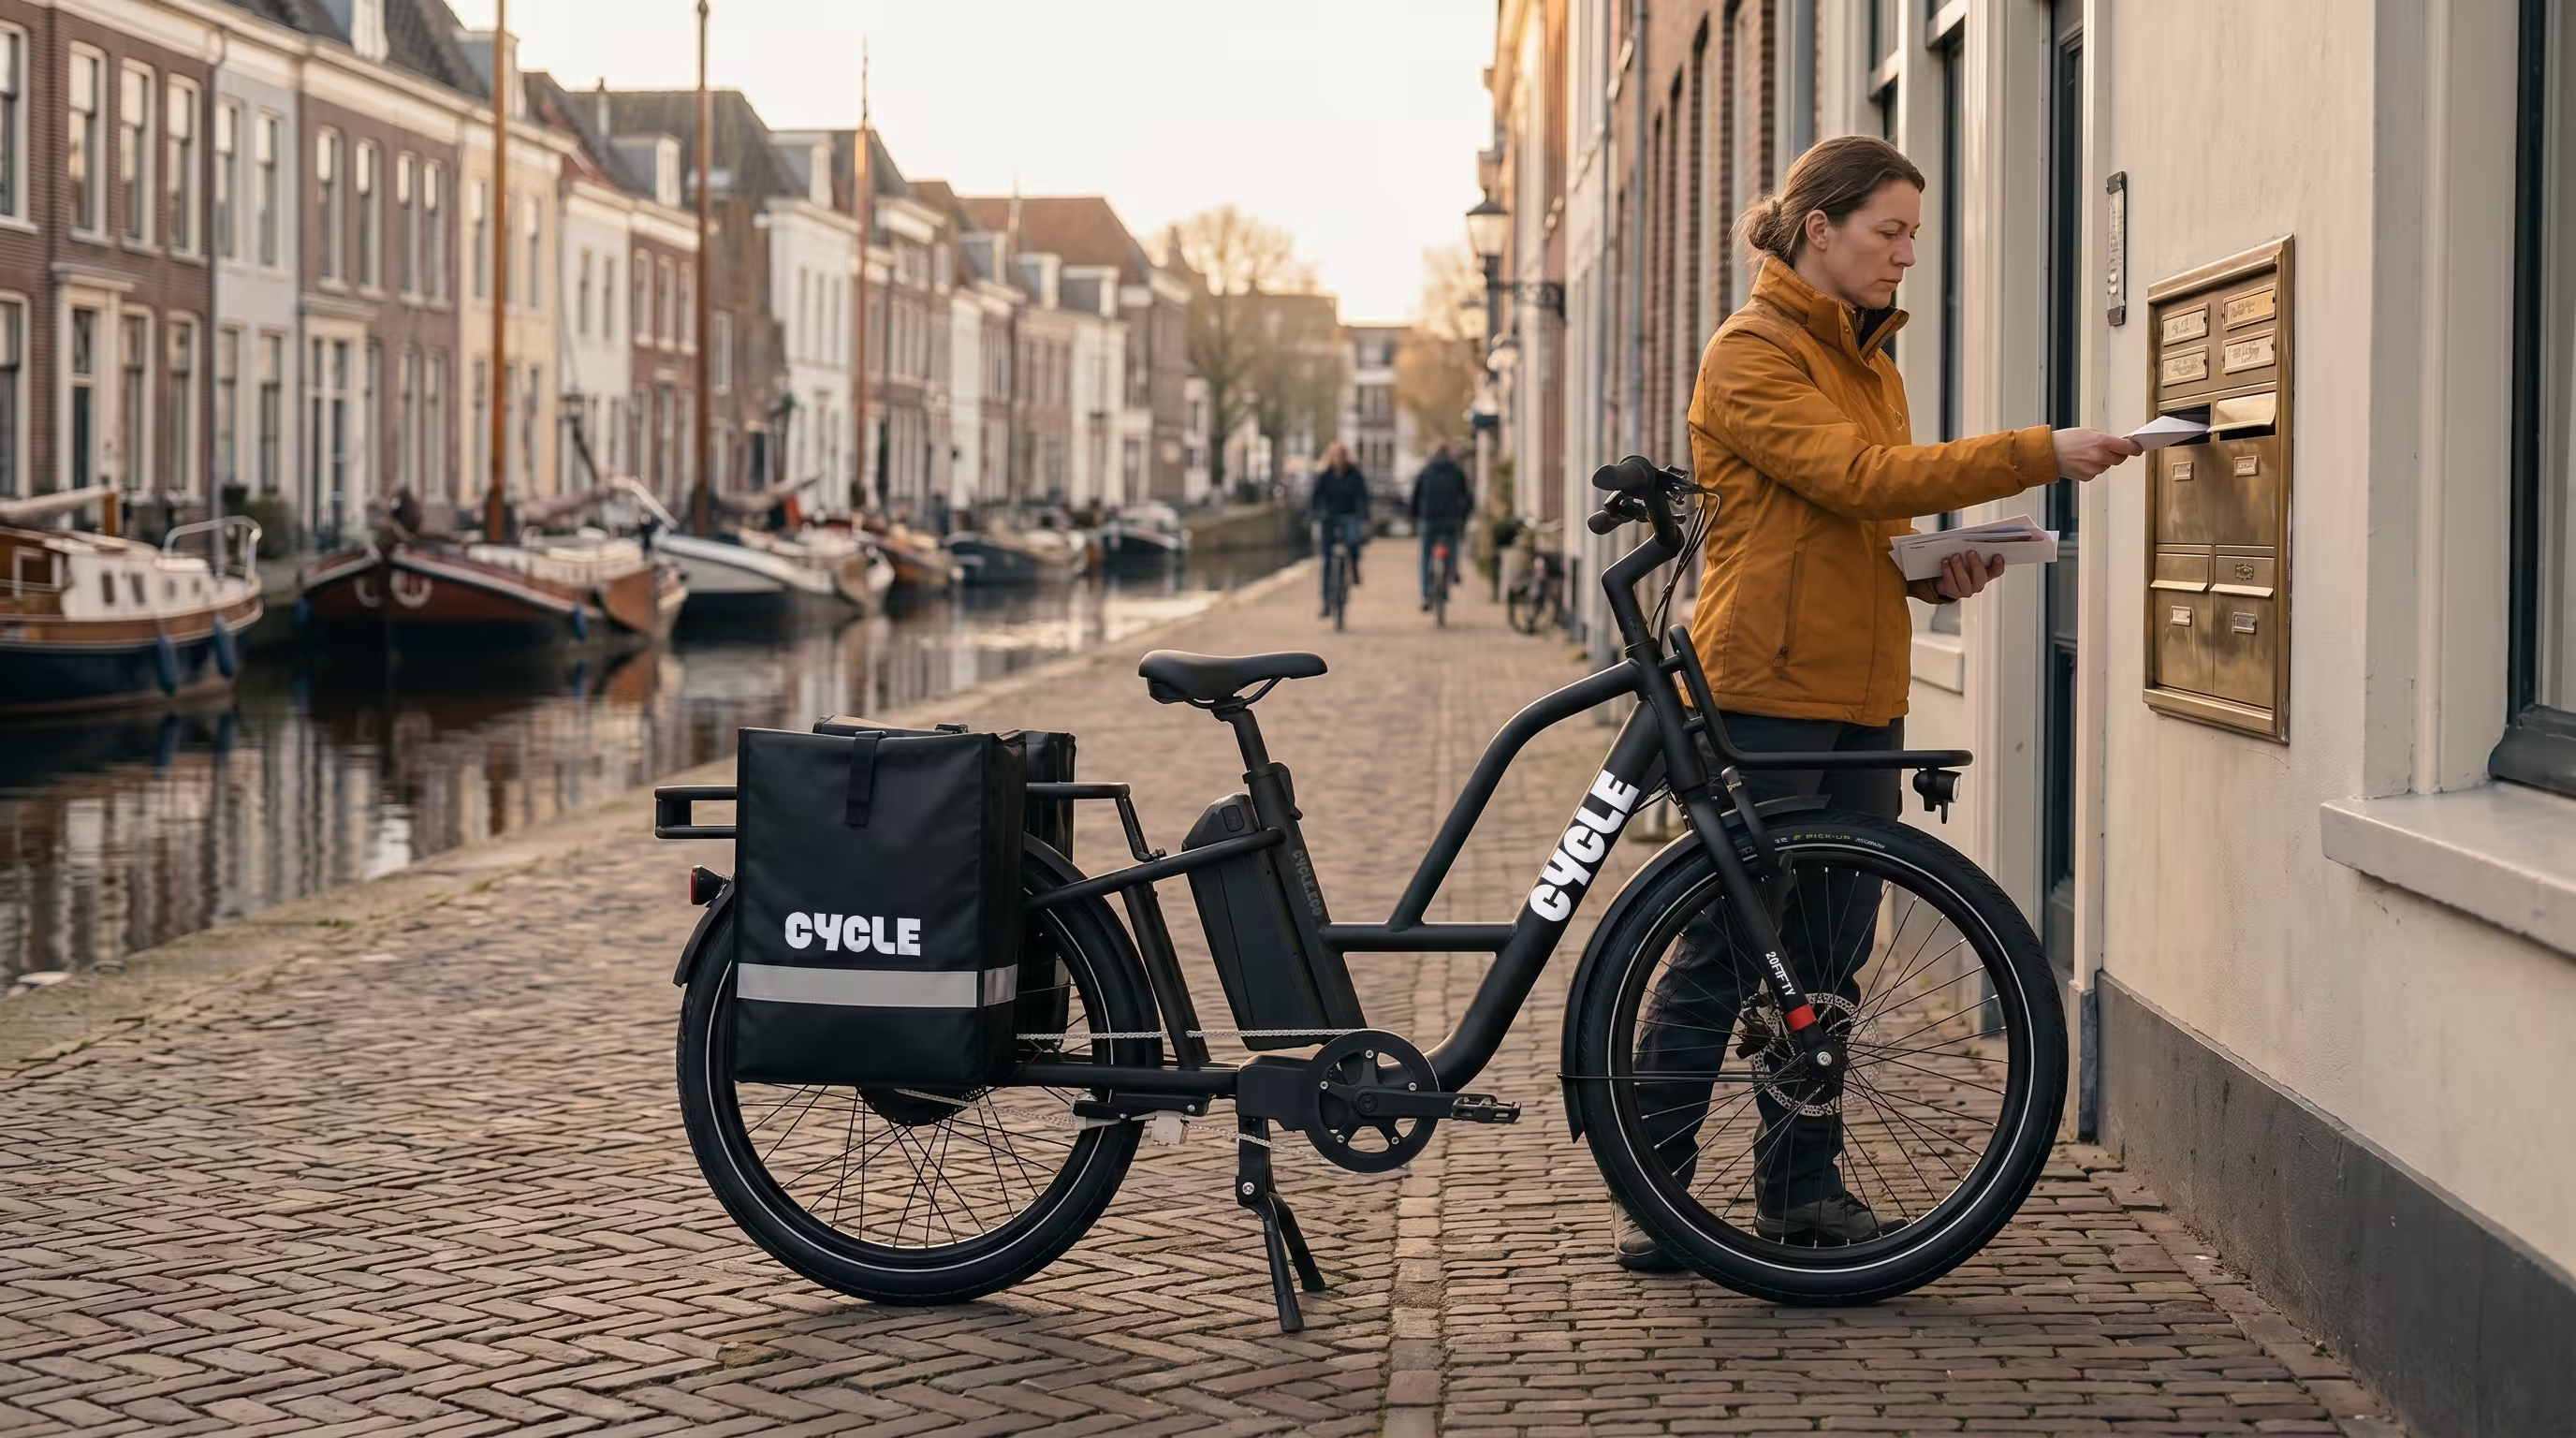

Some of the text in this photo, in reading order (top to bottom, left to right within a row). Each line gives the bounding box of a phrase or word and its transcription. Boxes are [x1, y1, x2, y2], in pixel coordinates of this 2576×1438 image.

[1530, 769, 1640, 922] CYCLE
[1293, 849, 1323, 916] CYCLE.ECO
[784, 911, 921, 956] CYCLE
[1765, 951, 1796, 996] 20FIFTY
